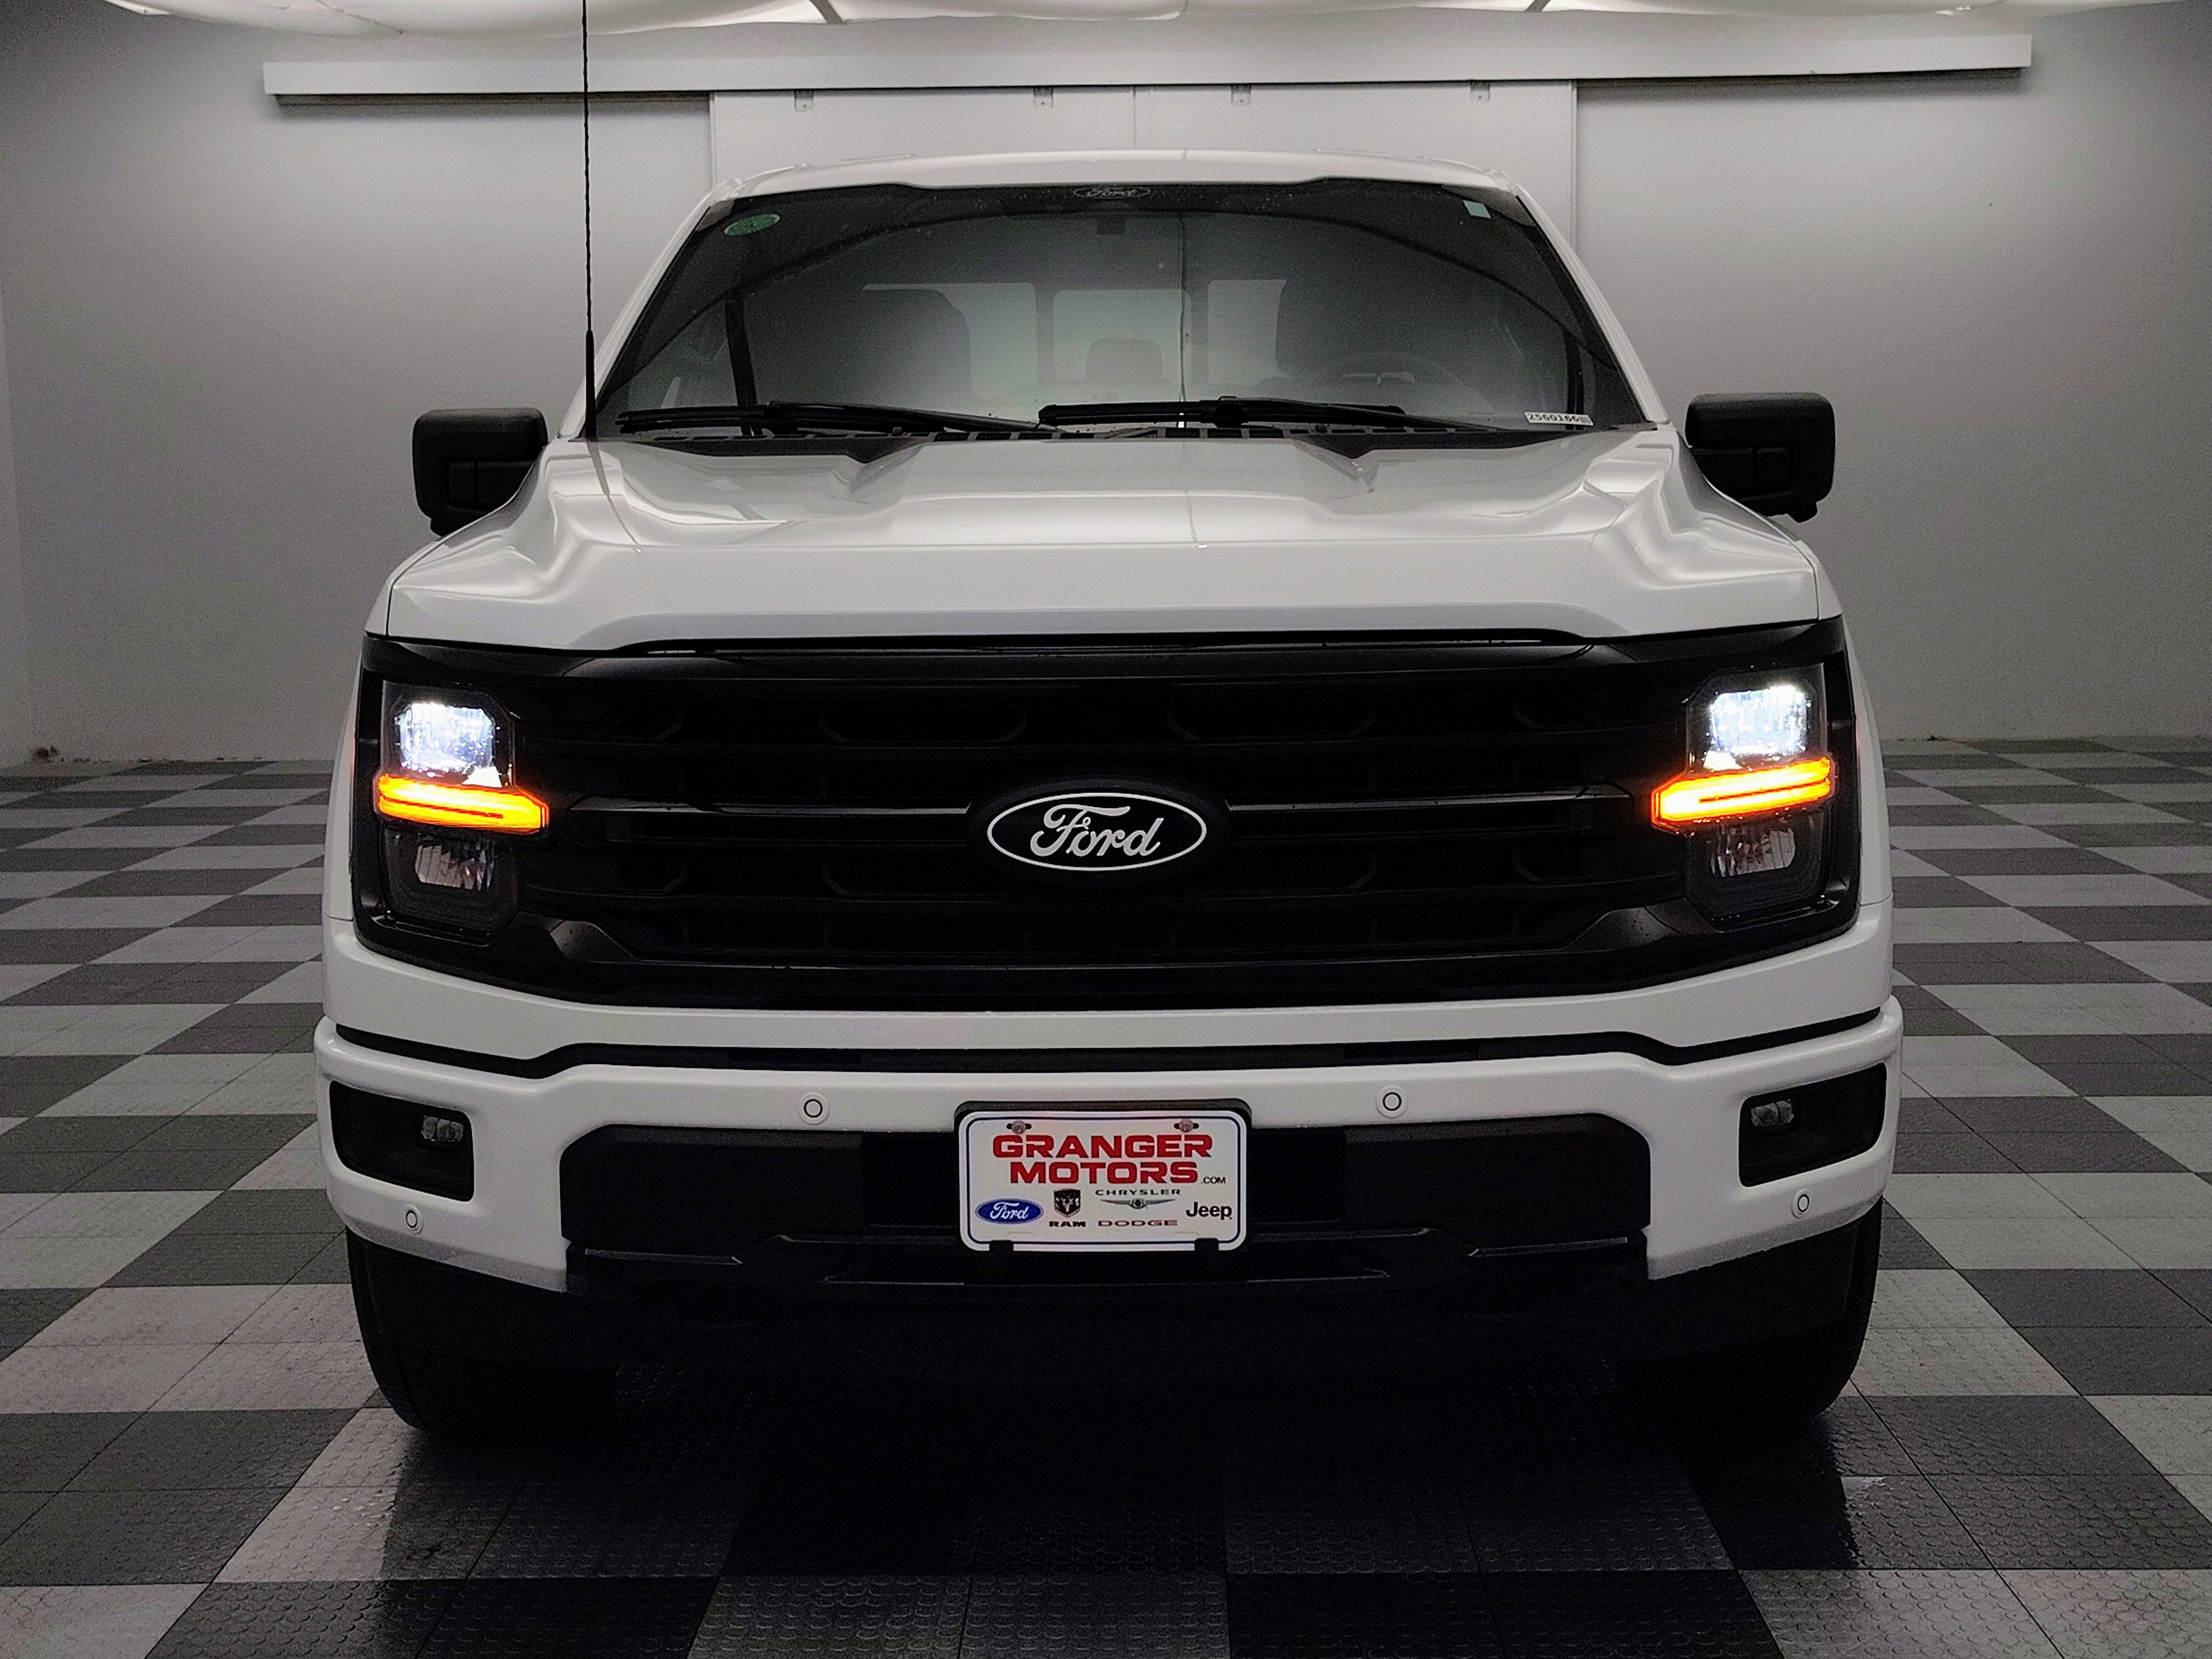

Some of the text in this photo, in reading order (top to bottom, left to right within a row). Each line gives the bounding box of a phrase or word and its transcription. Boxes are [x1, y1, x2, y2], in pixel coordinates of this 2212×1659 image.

[1030, 804, 1164, 857] Ford
[993, 1135, 1213, 1158] GRANGER
[1010, 1161, 1226, 1185] MOTORS .COM
[989, 1202, 1029, 1220] Ford
[1185, 1202, 1232, 1220] Jeep
